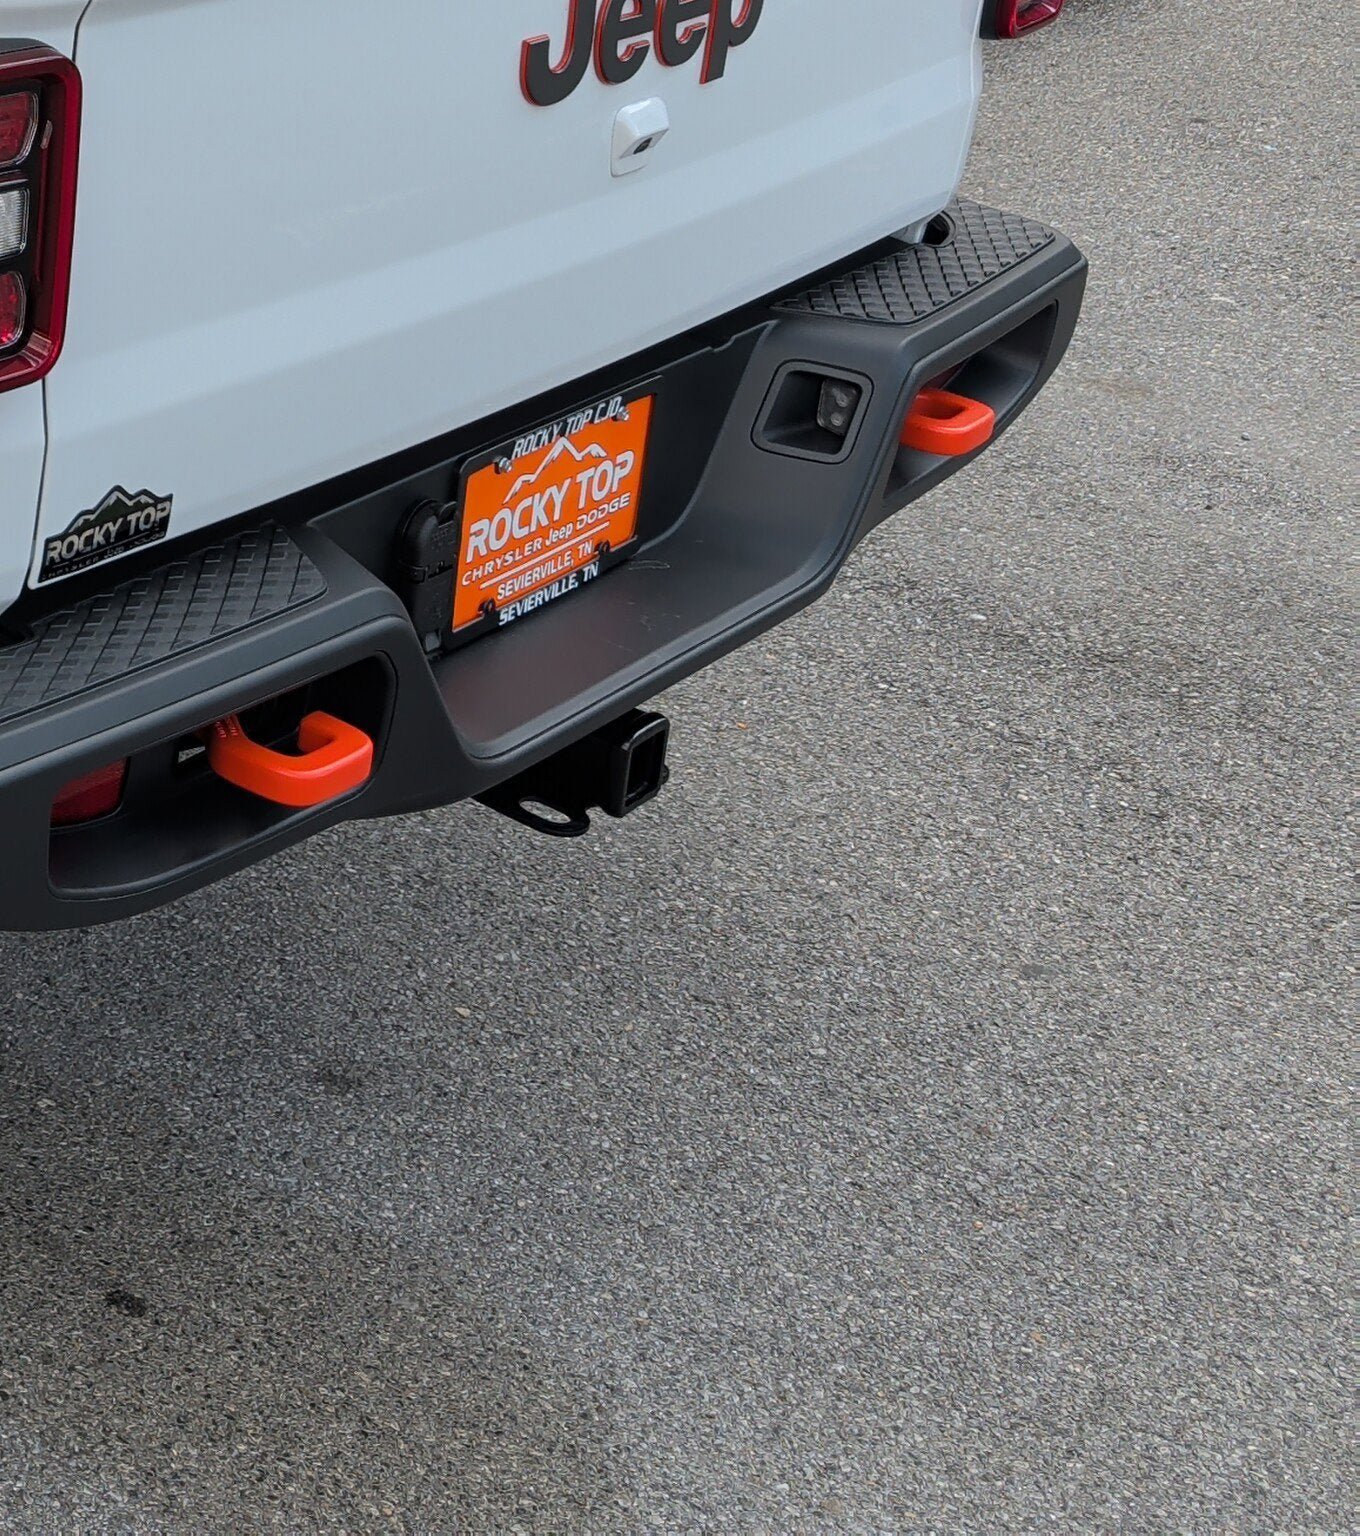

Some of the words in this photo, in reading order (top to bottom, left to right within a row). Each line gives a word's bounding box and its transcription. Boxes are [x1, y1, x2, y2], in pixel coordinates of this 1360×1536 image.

[511, 422, 563, 461] ROCKY
[565, 407, 594, 436] TOP
[45, 517, 124, 565] ROCKY
[127, 500, 171, 535] TOP
[465, 477, 572, 564] ROCKY
[575, 450, 635, 510] TOP
[462, 537, 542, 586] CHRYSLER
[545, 521, 574, 546] Jeep
[576, 492, 631, 530] DODGE
[577, 538, 595, 559] TN
[581, 561, 600, 583] TN
